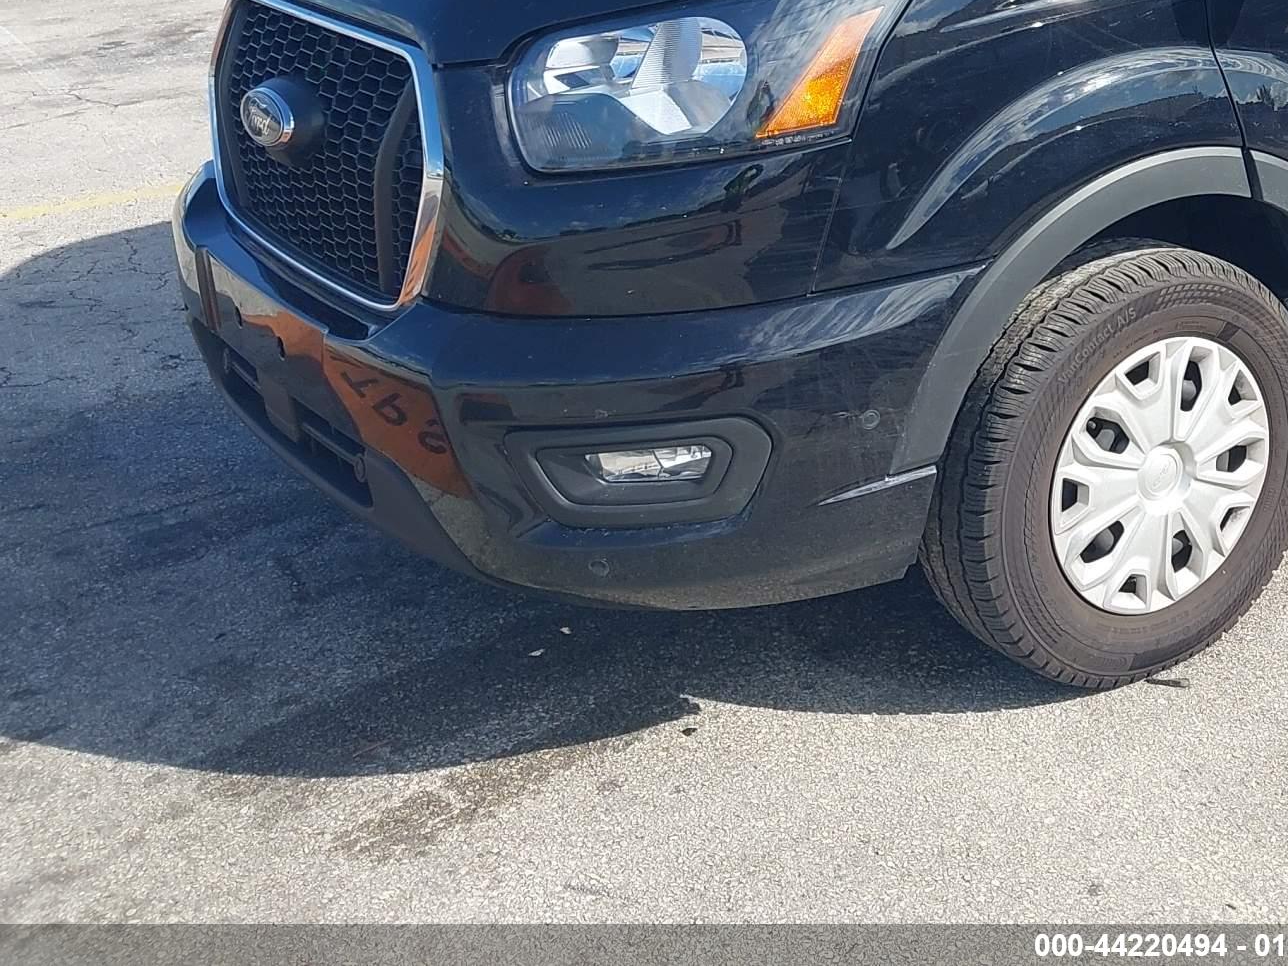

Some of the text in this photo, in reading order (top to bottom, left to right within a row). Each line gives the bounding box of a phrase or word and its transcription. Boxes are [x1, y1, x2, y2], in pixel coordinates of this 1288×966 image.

[248, 97, 271, 136] Ford
[1058, 307, 1137, 384] VanContact A/S
